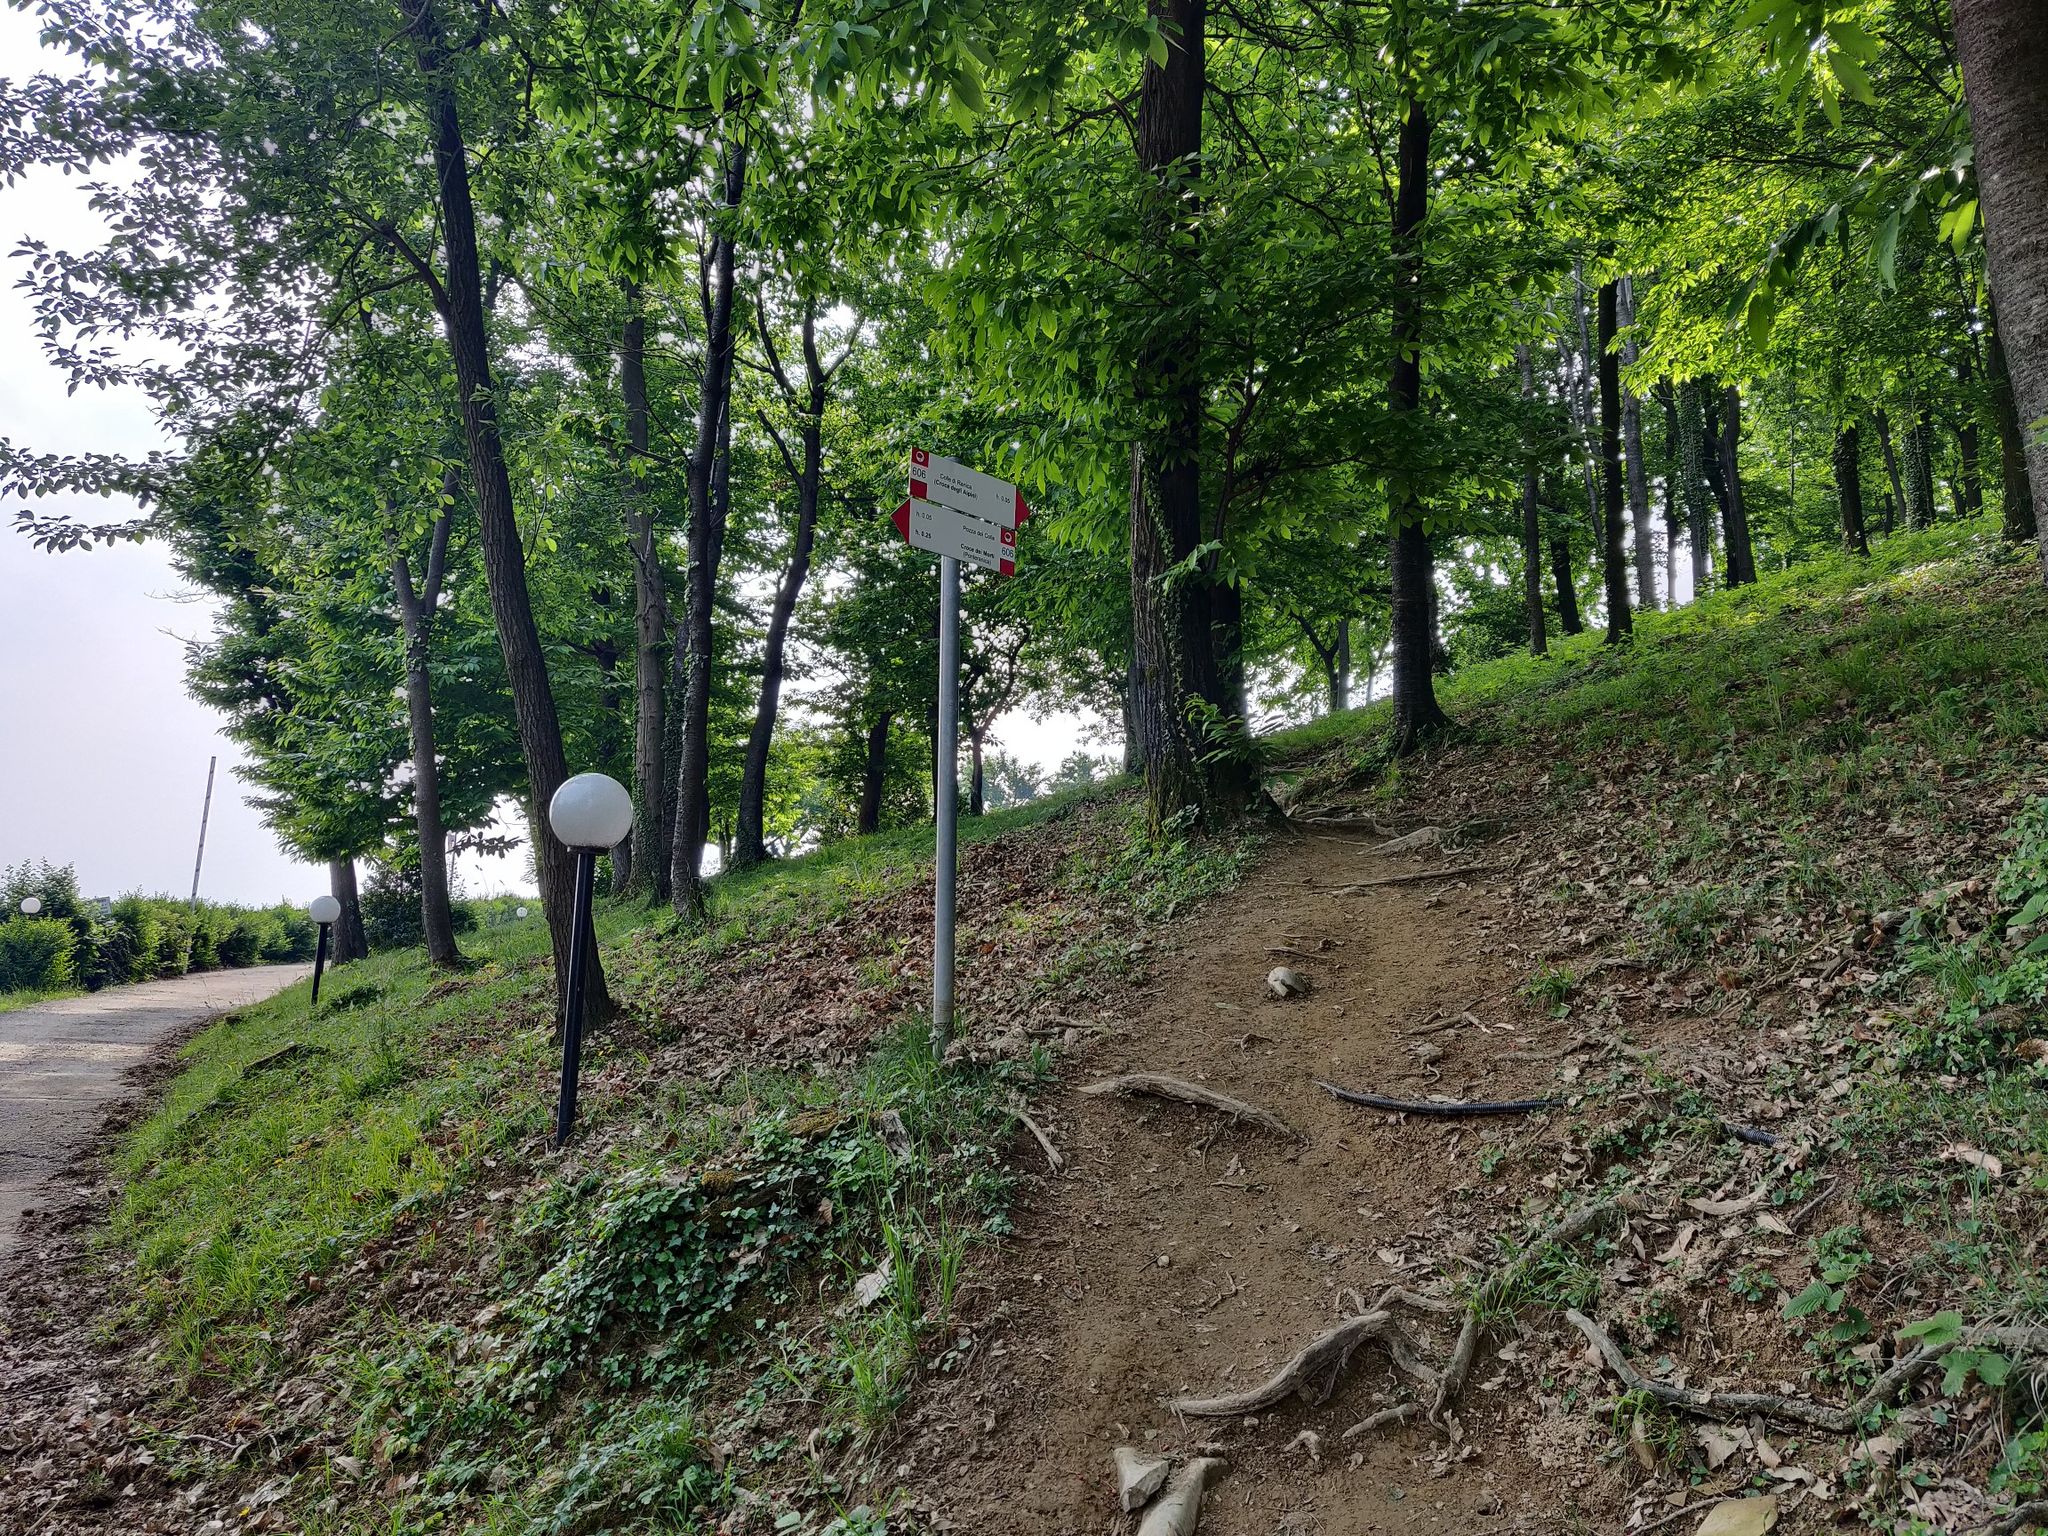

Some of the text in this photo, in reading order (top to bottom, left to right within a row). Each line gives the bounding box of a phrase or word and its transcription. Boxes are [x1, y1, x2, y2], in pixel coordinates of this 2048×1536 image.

[912, 466, 927, 479] 606
[960, 543, 975, 552] Croce
[1001, 546, 1014, 559] 606
